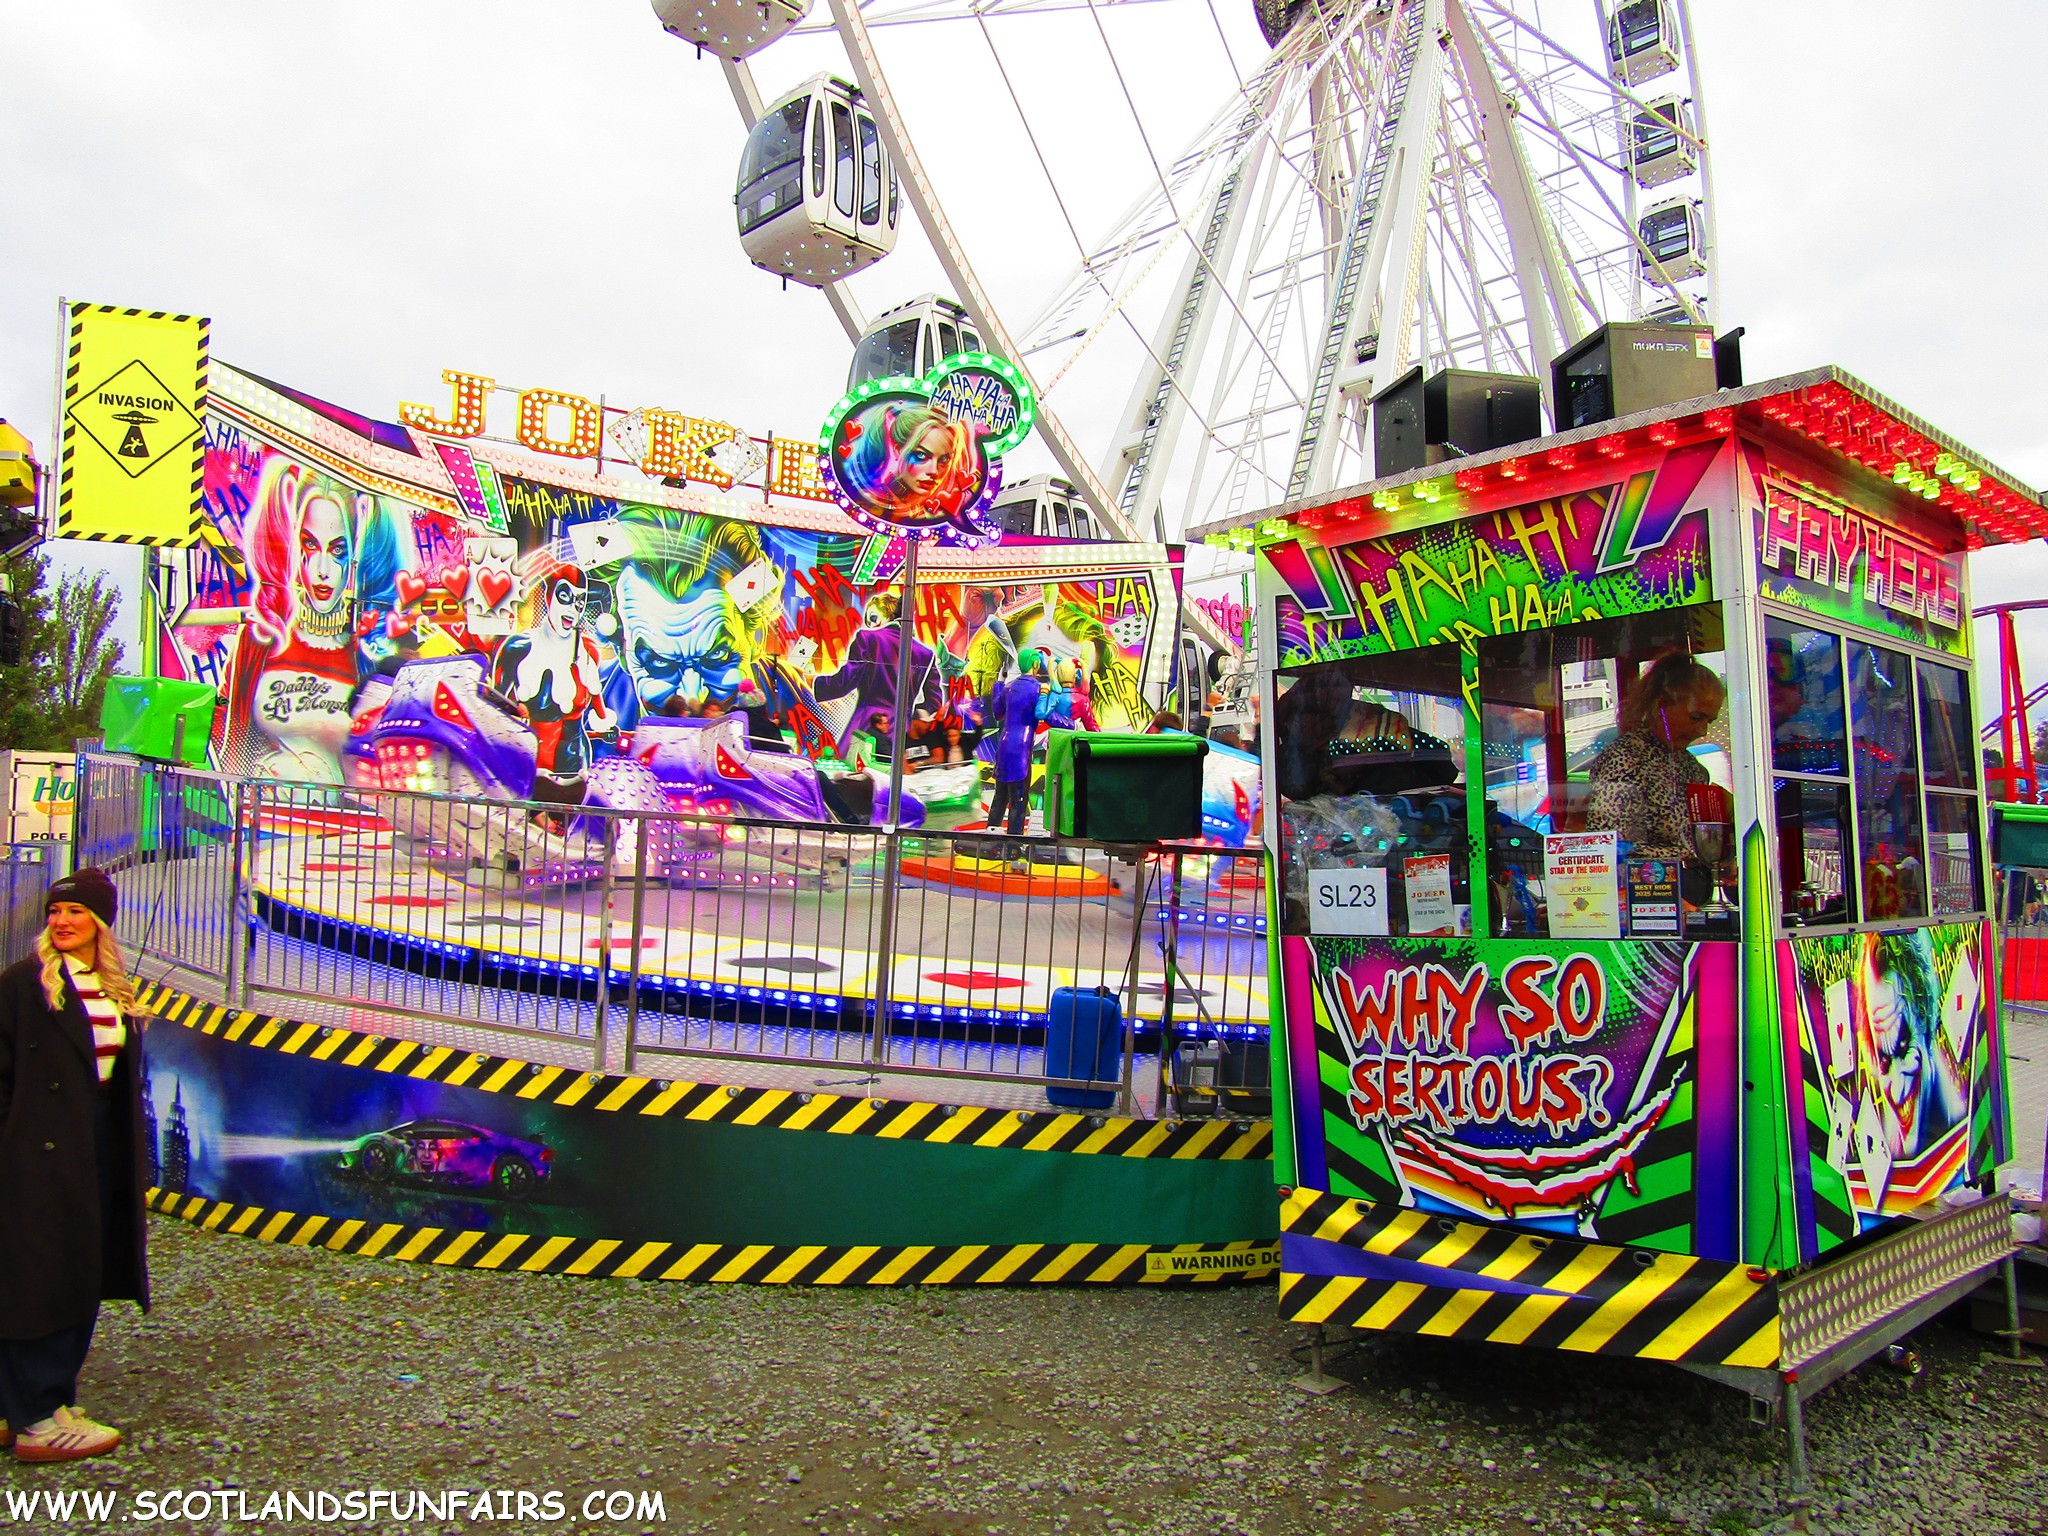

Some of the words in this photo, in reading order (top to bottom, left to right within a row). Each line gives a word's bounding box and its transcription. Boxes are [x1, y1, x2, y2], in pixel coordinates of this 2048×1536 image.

[98, 392, 174, 412] INVASION
[1760, 473, 1860, 594] PAY
[1862, 519, 1959, 631] HERE
[31, 832, 68, 841] POLE
[1558, 854, 1605, 866] CERTIFICATE
[1549, 866, 1566, 875] STAR
[1567, 866, 1575, 874] OF
[1576, 865, 1588, 874] THE
[1589, 864, 1609, 873] SHOW
[1319, 884, 1377, 908] SL23
[1411, 889, 1446, 899] JOKER
[1570, 885, 1592, 893] JOKER
[1633, 905, 1678, 913] JOKER
[1332, 962, 1488, 1057] WHY
[1498, 952, 1607, 1057] SO
[1346, 1050, 1614, 1139] SERIOUS?
[1171, 1254, 1256, 1270] WARNING
